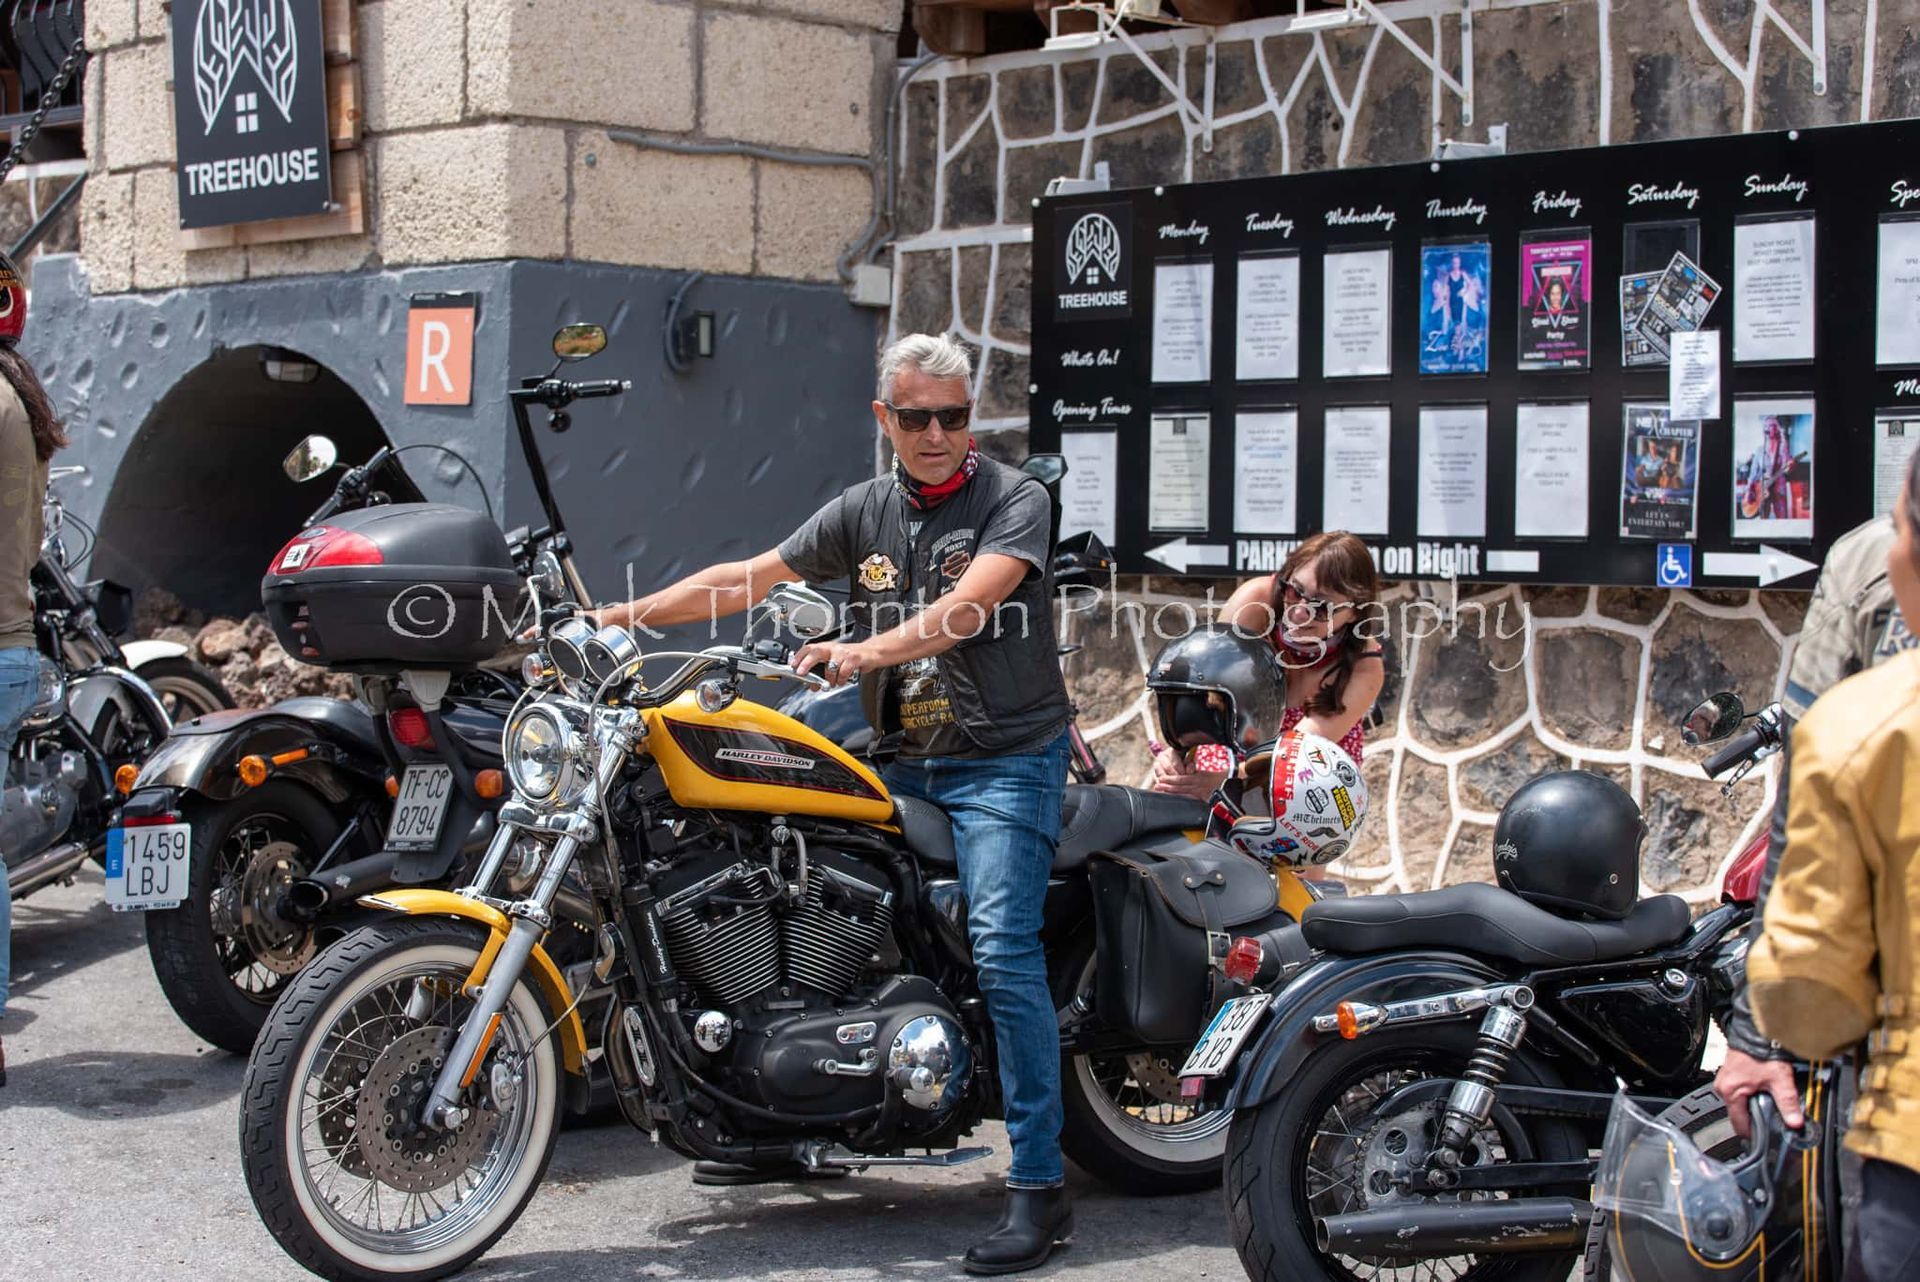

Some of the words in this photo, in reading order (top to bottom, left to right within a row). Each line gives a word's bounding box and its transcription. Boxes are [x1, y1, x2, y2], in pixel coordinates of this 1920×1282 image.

[185, 147, 319, 197] TREEHOUSE
[1627, 181, 1700, 210] Saturday
[1744, 173, 1808, 202] Sunday
[1325, 204, 1397, 231] Wednesday
[1426, 198, 1488, 225] Thursday
[1532, 190, 1583, 218] Friday
[1158, 219, 1210, 245] Monday
[1246, 212, 1294, 238] Tuesday
[1058, 290, 1127, 309] TREEHOUSE
[420, 320, 454, 393] R
[1060, 349, 1095, 367] Whats
[1096, 348, 1120, 367] On!
[1052, 398, 1098, 422] Opening
[1100, 396, 1132, 415] Times
[1383, 546, 1413, 574] on
[396, 805, 438, 836] 8794
[1279, 817, 1301, 838] LET'S
[1300, 835, 1320, 852] RIDE
[130, 831, 186, 864] 1459
[126, 864, 170, 897] LBJ
[1186, 1037, 1233, 1070] BXB
